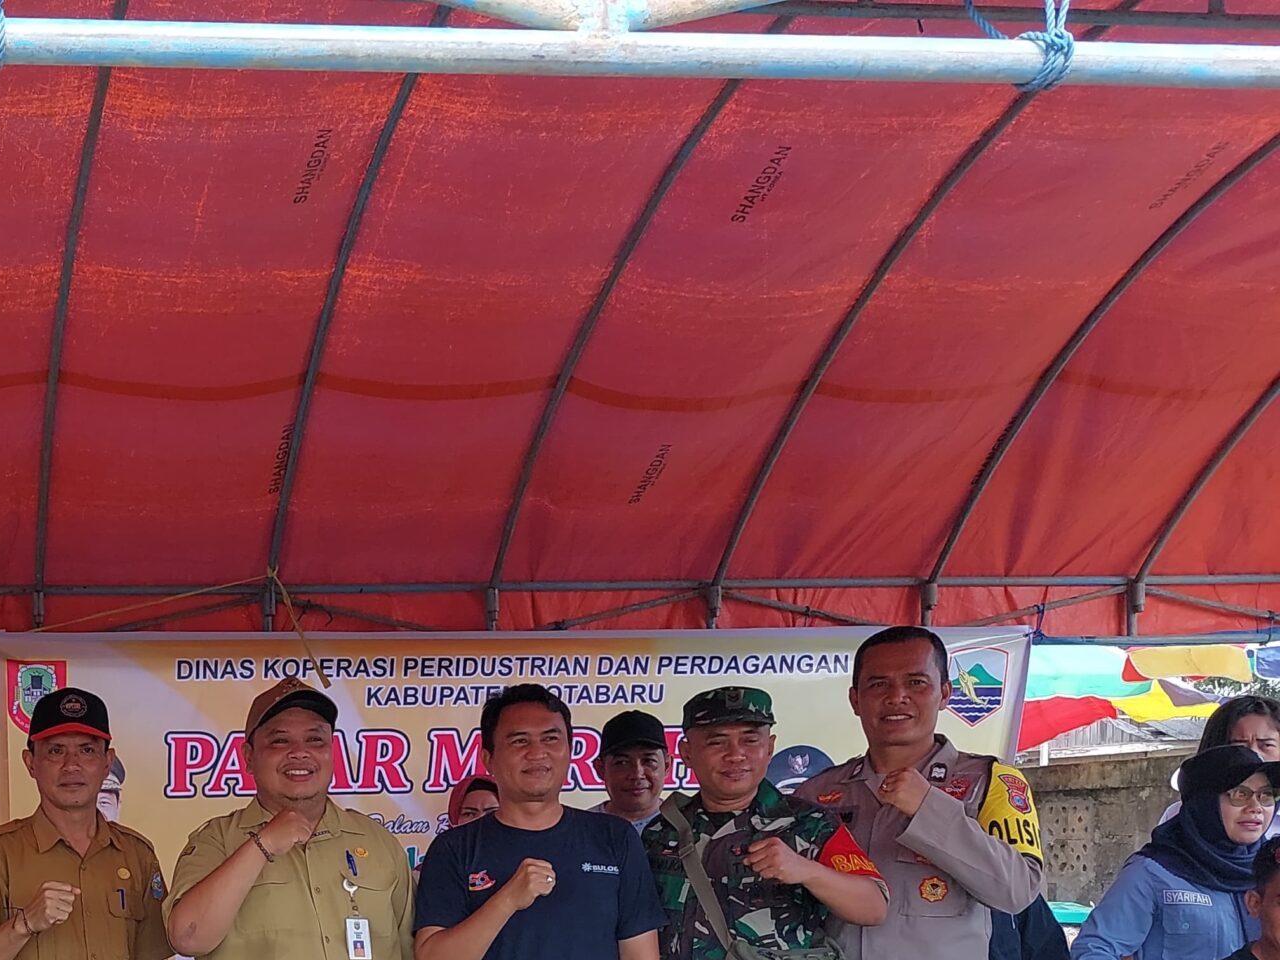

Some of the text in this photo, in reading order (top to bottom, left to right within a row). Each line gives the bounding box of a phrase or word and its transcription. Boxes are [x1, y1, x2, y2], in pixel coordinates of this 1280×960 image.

[293, 129, 333, 204] SHANGDAN
[730, 146, 792, 223] SHANGDAN
[628, 444, 673, 504] SHANGDAN
[177, 654, 850, 679] DINAS KOPERASI PERIDUSTRIAN DAN PERDAGANGAN
[366, 685, 506, 706] KABUPATE
[1166, 891, 1210, 904] SYARIFAH
